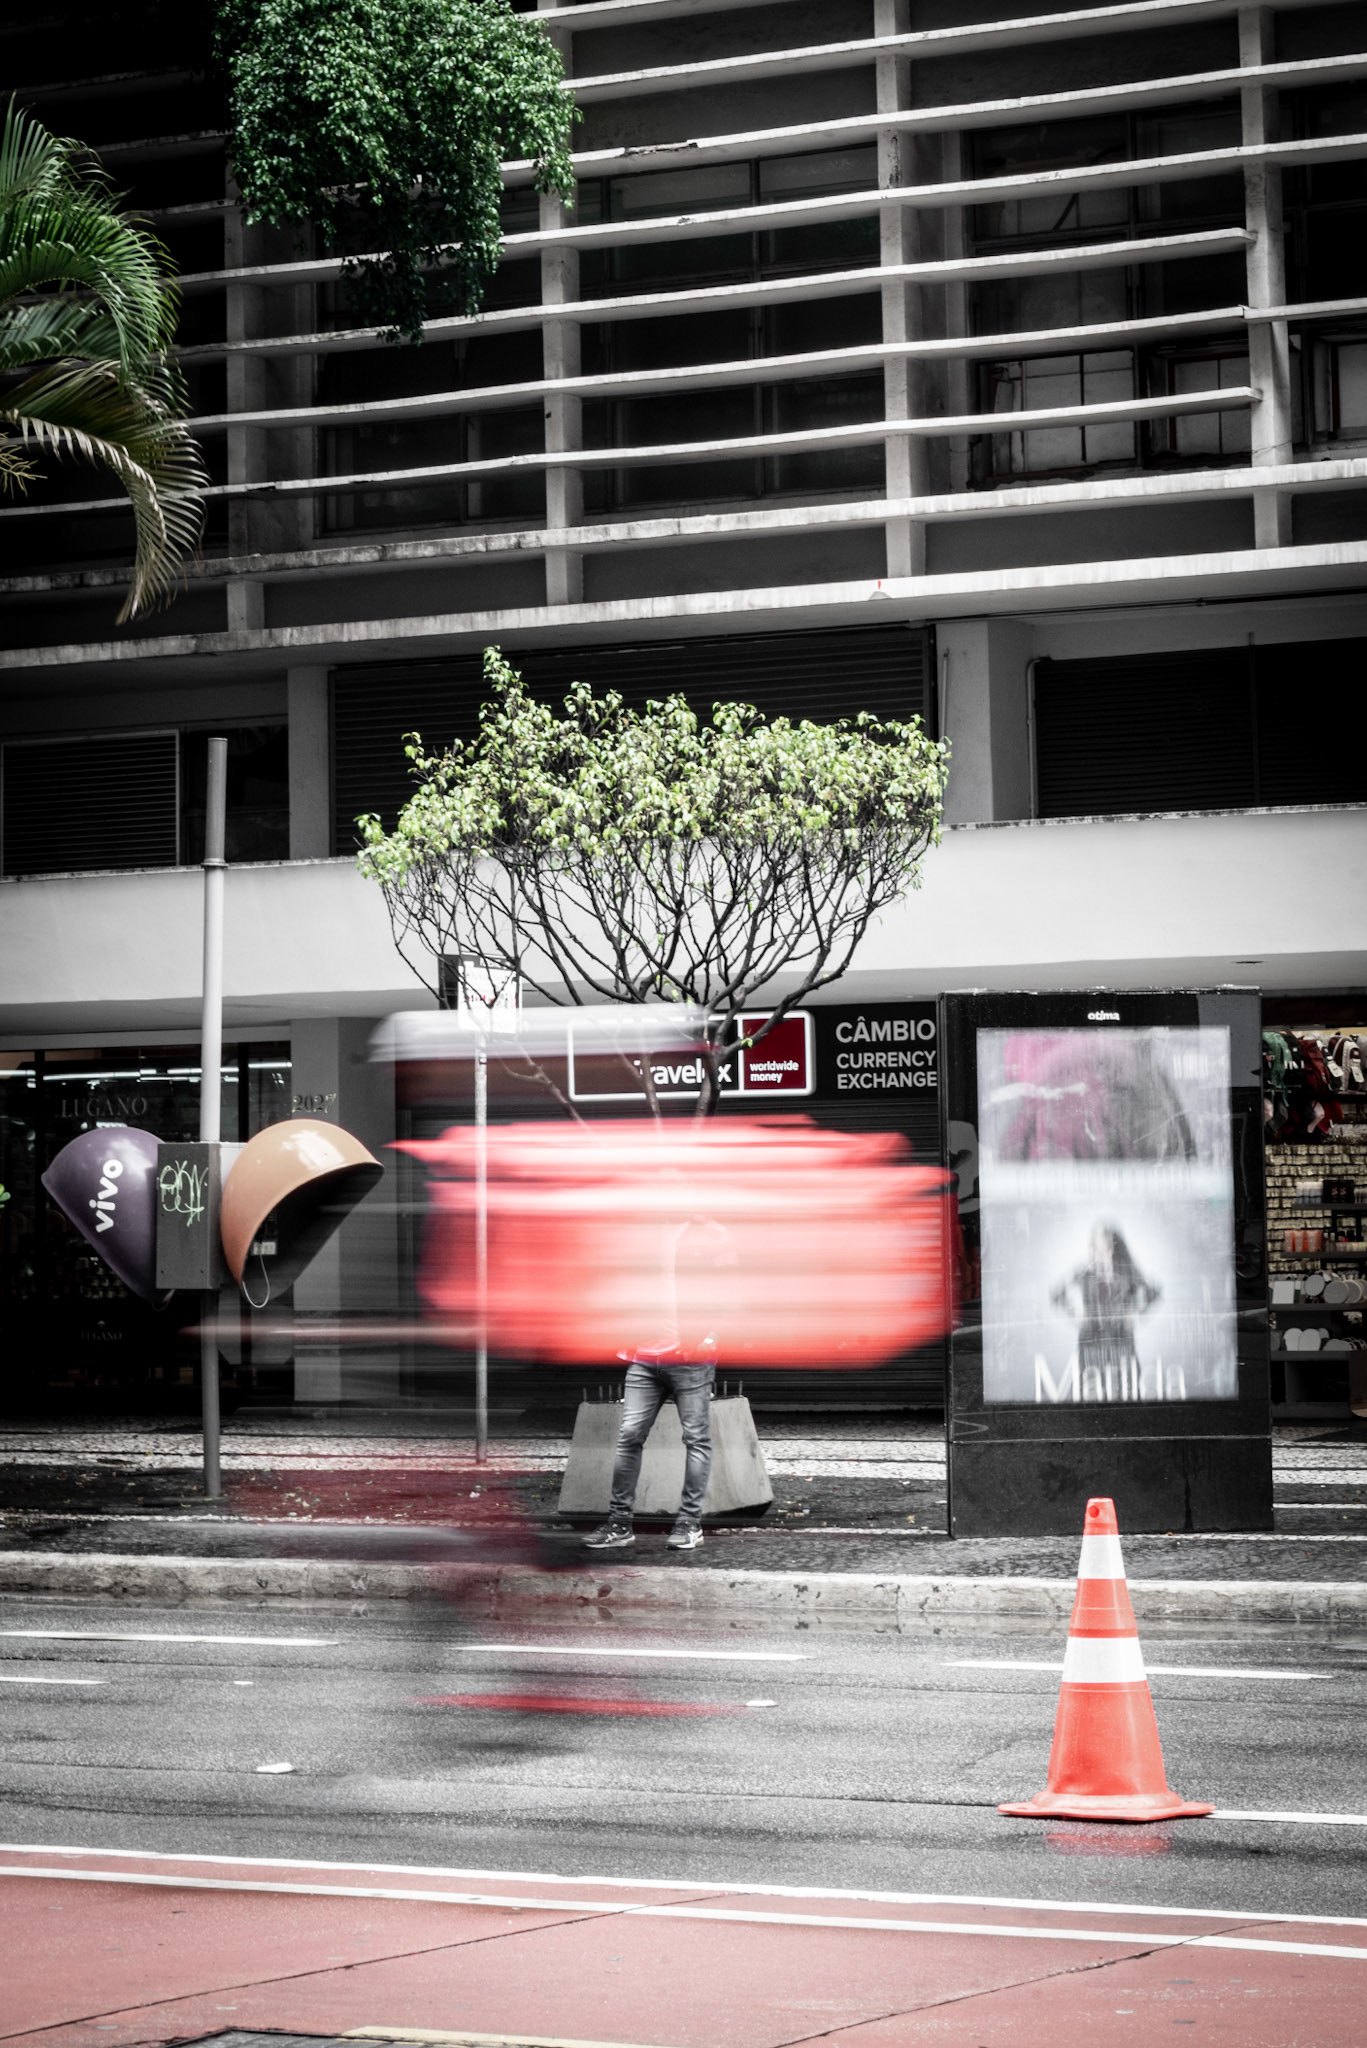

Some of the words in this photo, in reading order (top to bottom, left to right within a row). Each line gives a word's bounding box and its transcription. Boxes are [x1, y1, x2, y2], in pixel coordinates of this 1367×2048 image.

[835, 1016, 936, 1043] CÂMBIO
[750, 1060, 799, 1071] worldwide
[836, 1050, 936, 1069] CURRENCY
[634, 1058, 732, 1084] ravelx
[750, 1072, 783, 1083] money
[837, 1071, 938, 1089] EXCHANGE
[61, 1096, 147, 1118] LUGANO
[292, 1093, 337, 1113] 2027
[89, 1159, 123, 1233] vivo
